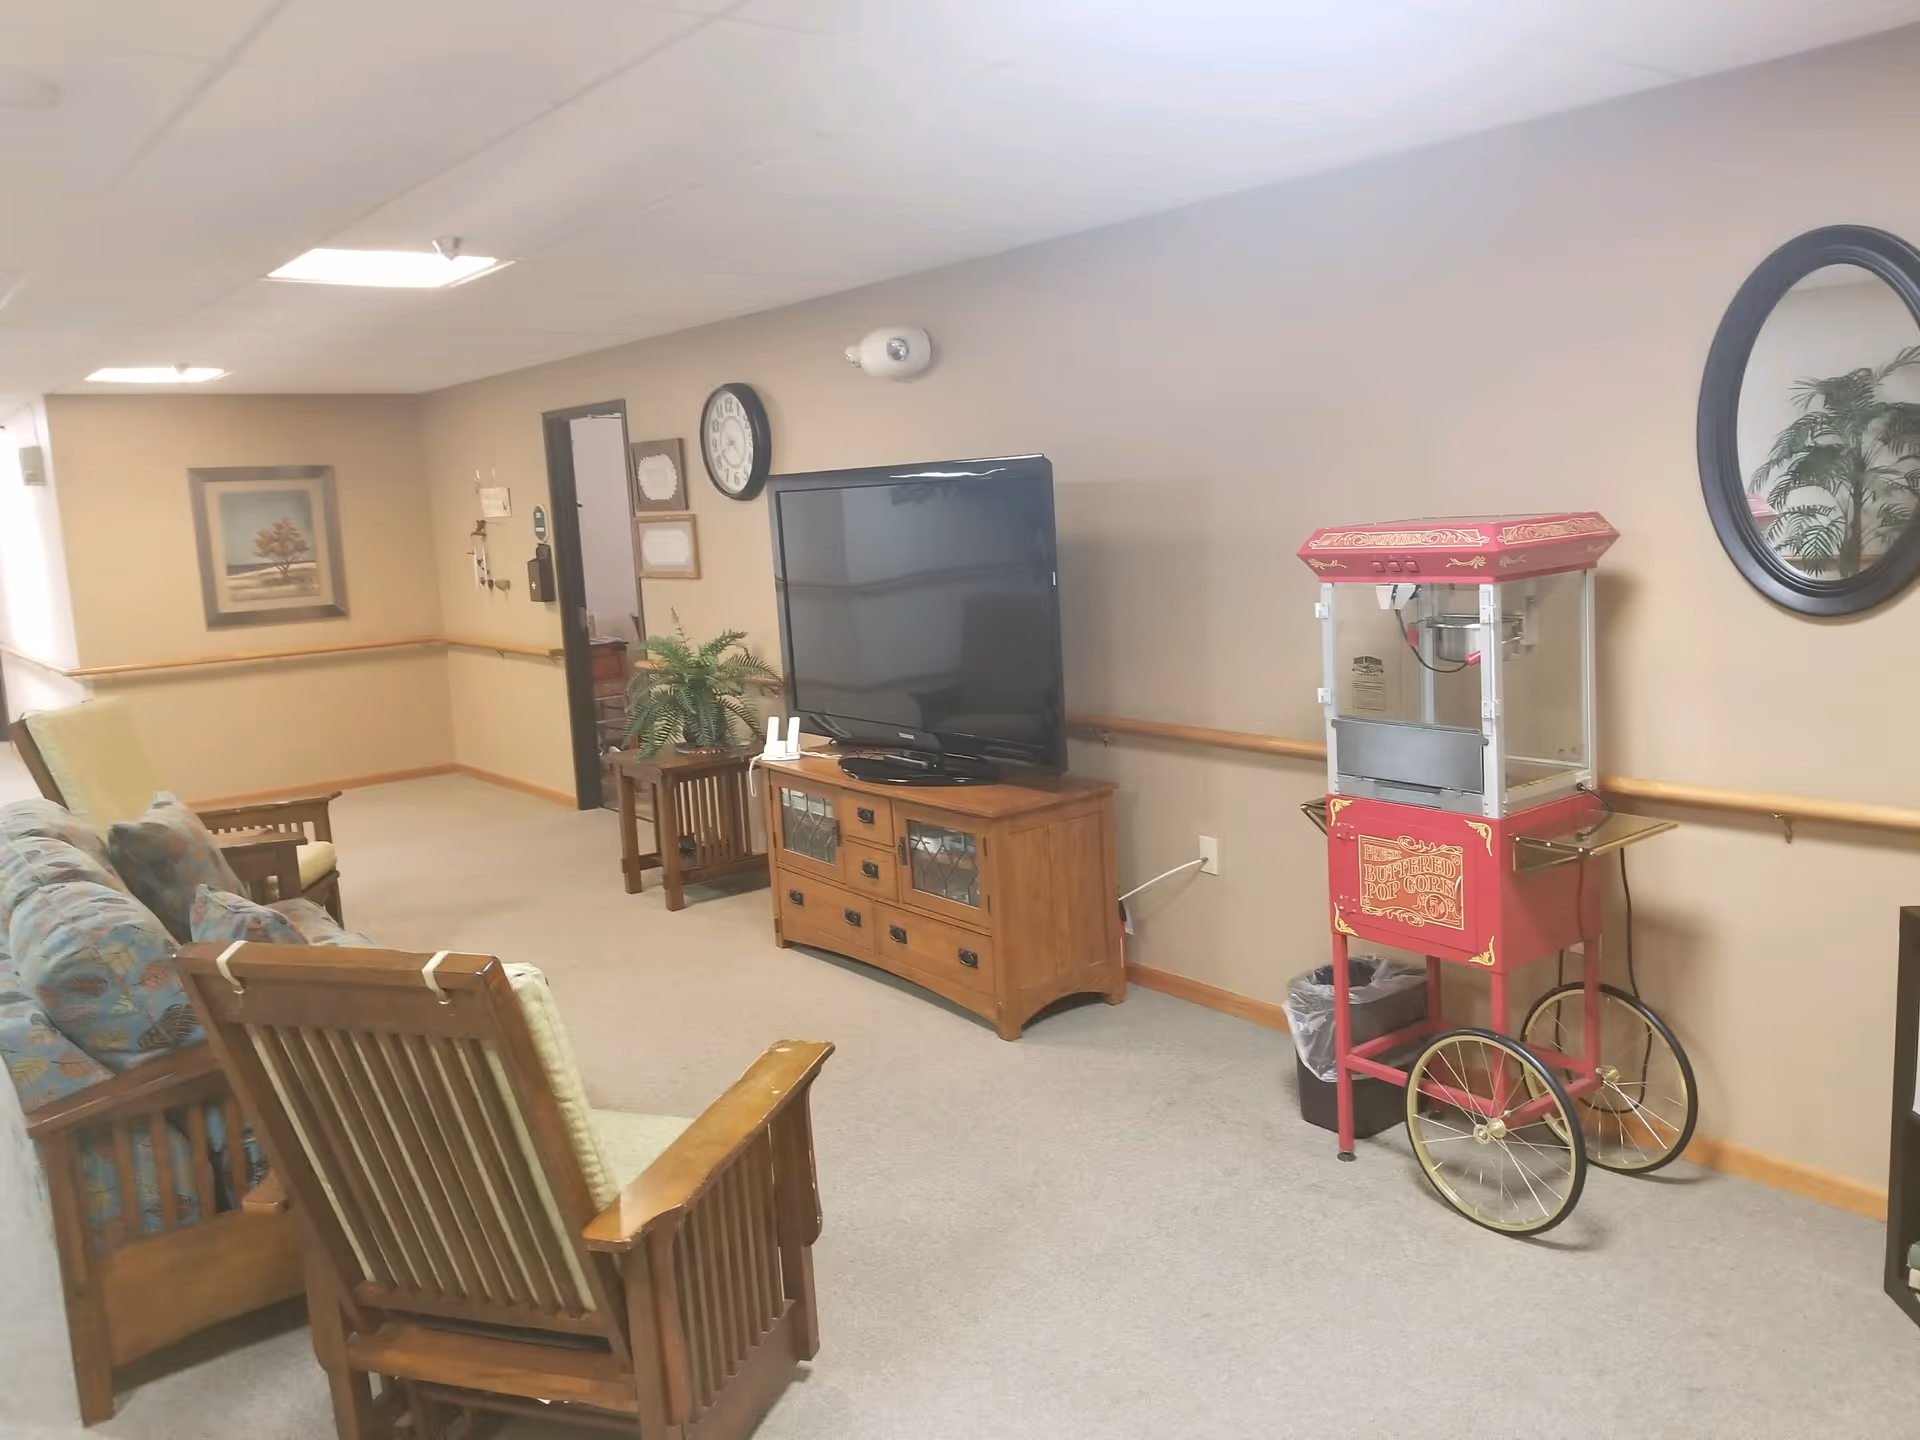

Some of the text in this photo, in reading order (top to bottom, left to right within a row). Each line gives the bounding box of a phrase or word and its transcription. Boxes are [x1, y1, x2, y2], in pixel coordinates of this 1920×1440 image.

[1364, 855, 1456, 883] BUTTERED
[1365, 875, 1456, 901] POP CORN
